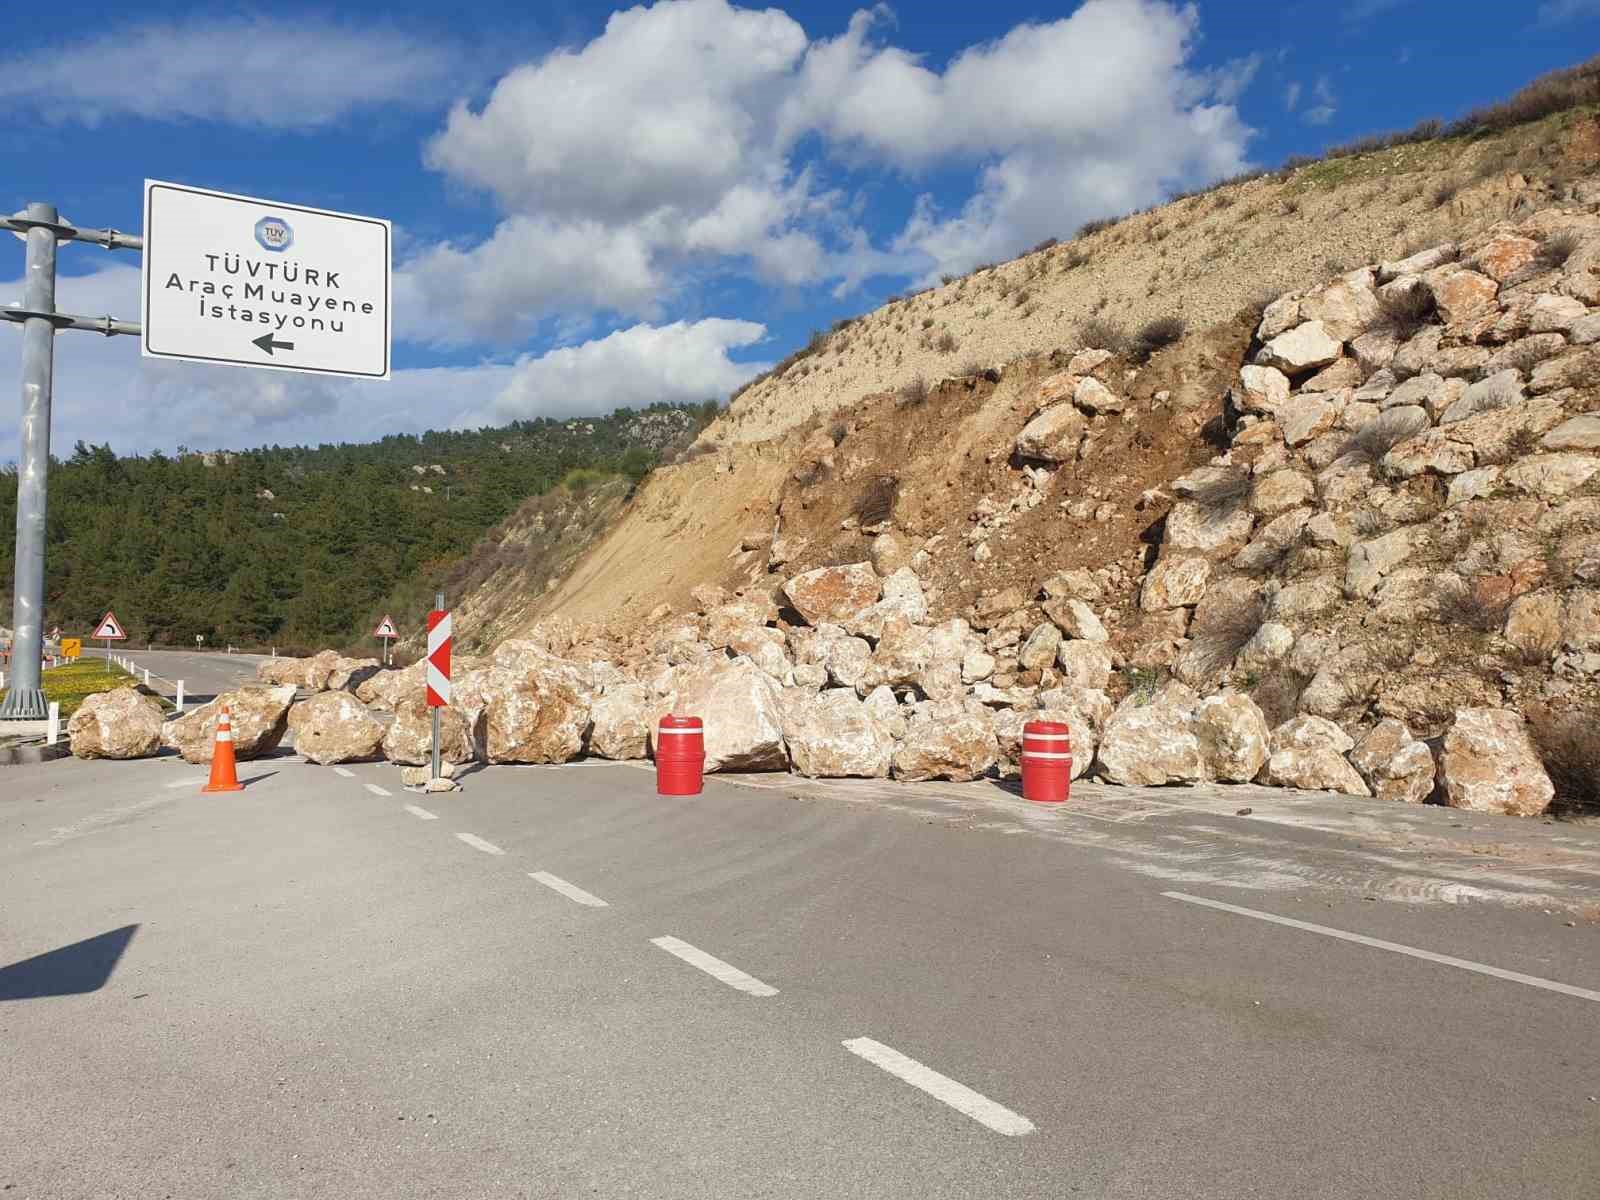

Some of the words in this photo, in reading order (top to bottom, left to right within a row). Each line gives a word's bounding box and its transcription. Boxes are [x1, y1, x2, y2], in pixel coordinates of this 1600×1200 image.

[204, 252, 340, 289] TÜVTÜRK
[165, 272, 233, 300] Araç
[244, 282, 374, 316] Muayene
[200, 295, 344, 333] İstasyonu
